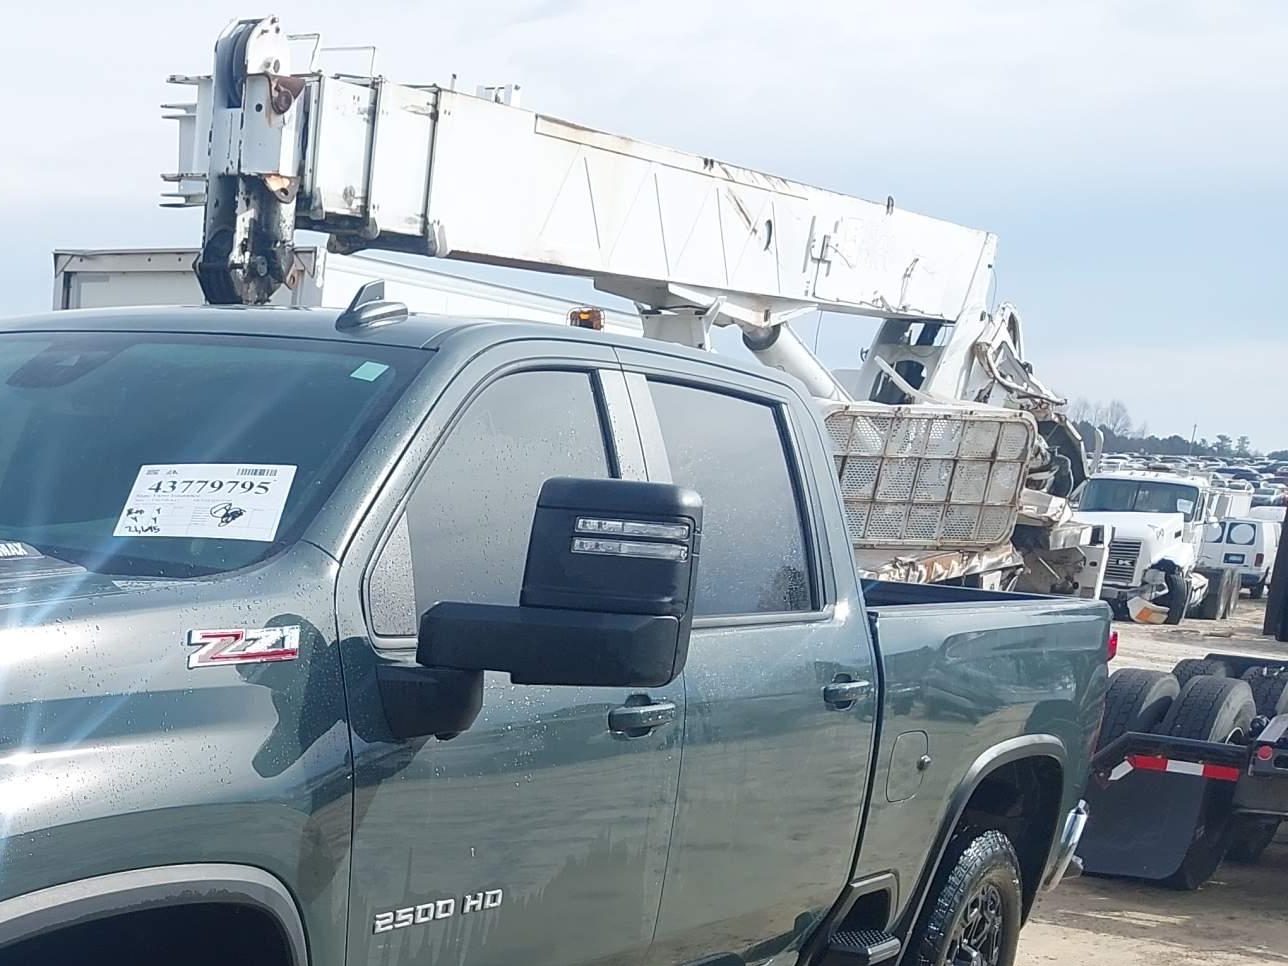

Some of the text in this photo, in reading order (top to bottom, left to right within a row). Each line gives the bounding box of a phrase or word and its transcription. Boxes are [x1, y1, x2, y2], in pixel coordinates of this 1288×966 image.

[148, 480, 272, 495] 43779795
[187, 625, 301, 669] Z71
[373, 888, 504, 934] 2500 HD
